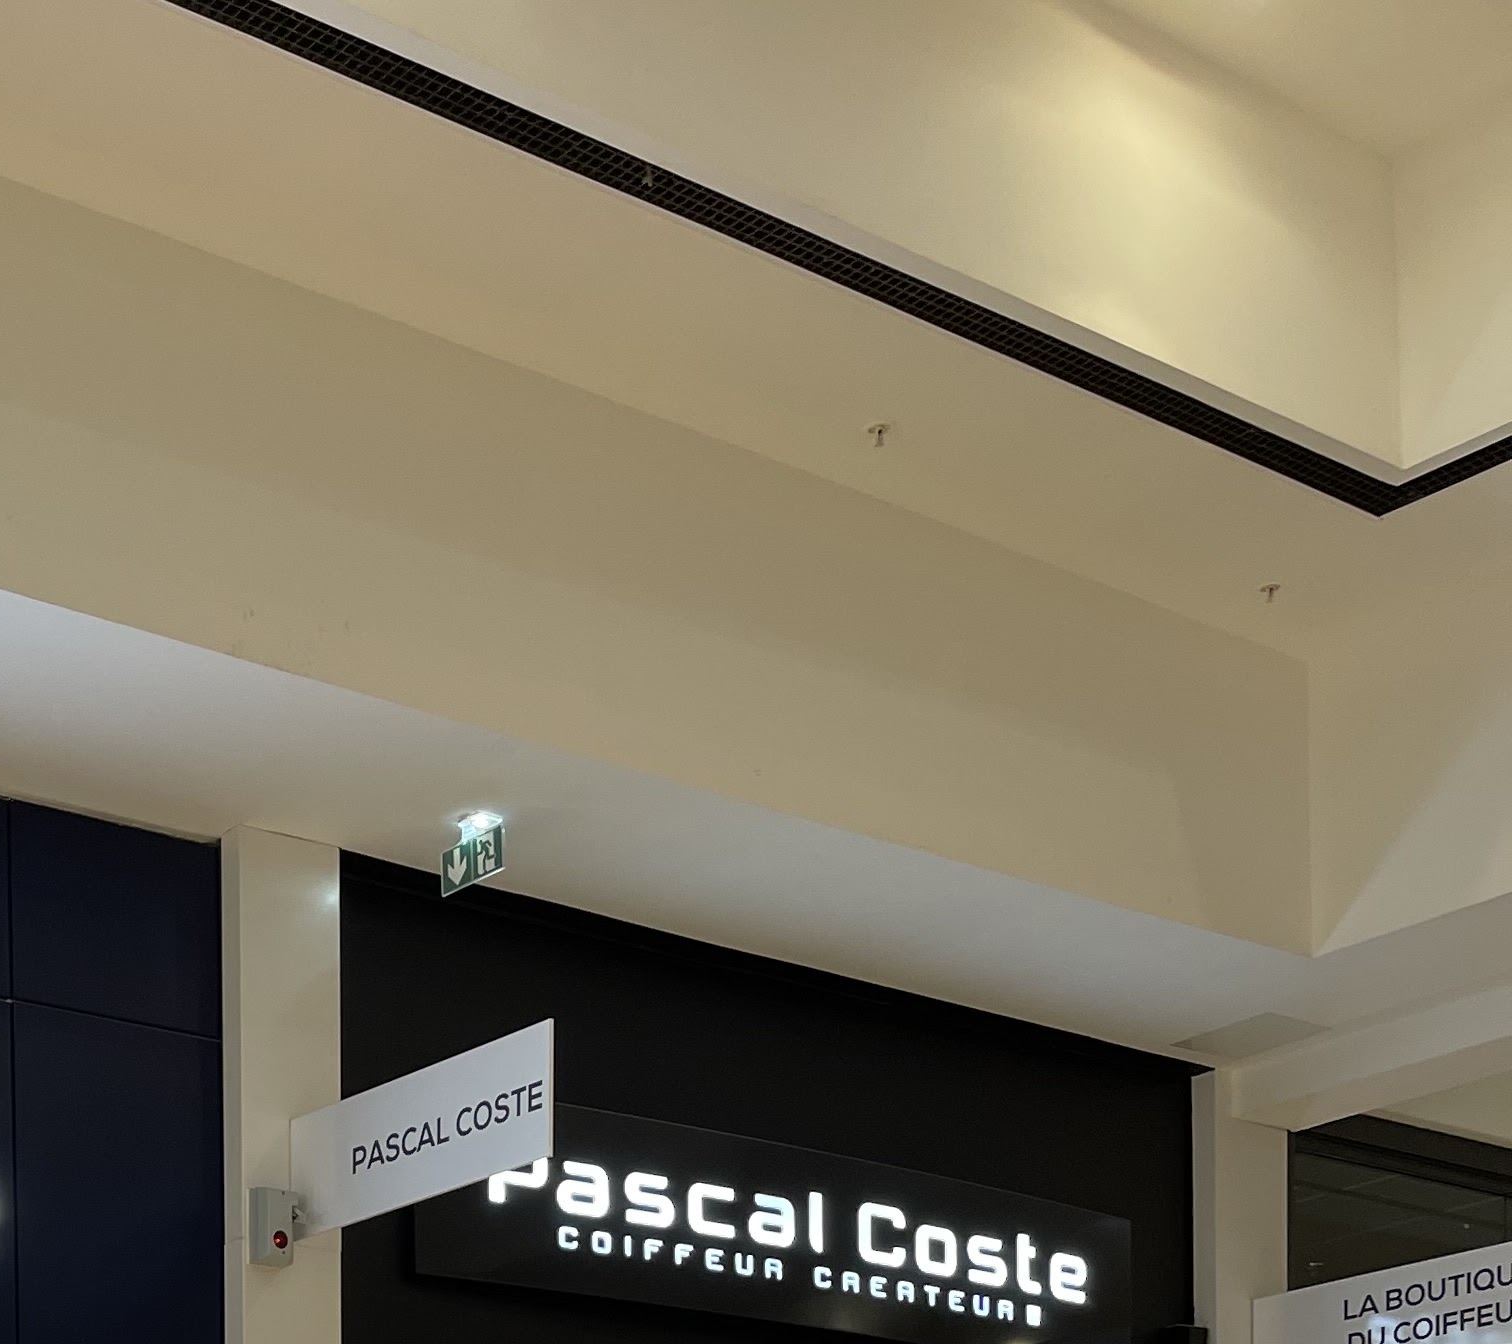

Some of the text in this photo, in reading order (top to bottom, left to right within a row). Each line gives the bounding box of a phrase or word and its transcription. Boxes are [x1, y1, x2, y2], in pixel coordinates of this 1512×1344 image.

[352, 1080, 543, 1175] PASCAL COSTE
[558, 1225, 784, 1281] COIFFEUR
[857, 1202, 1088, 1305] Coste
[1343, 1294, 1380, 1321] LA
